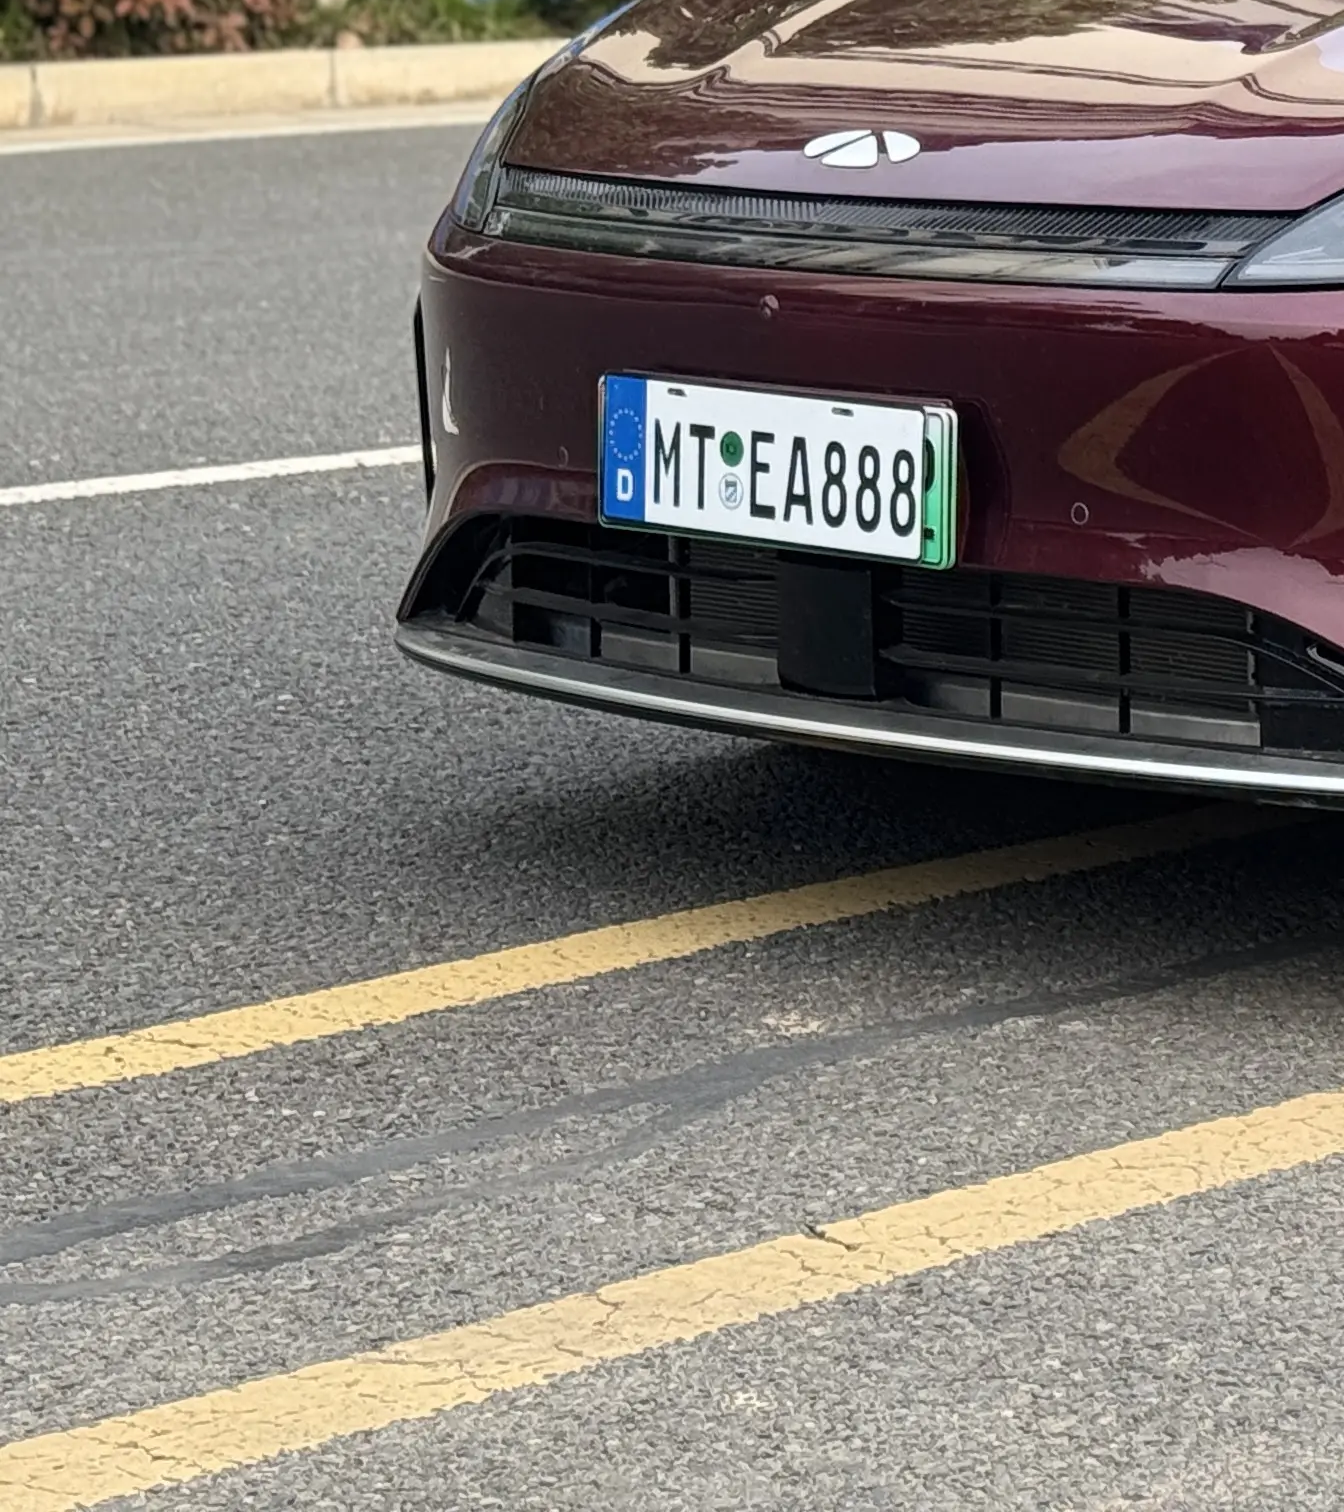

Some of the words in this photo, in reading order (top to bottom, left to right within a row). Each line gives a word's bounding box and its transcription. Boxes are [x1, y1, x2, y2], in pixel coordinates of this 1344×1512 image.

[616, 468, 634, 502] D
[653, 418, 716, 510] MT
[749, 430, 917, 537] EA888
